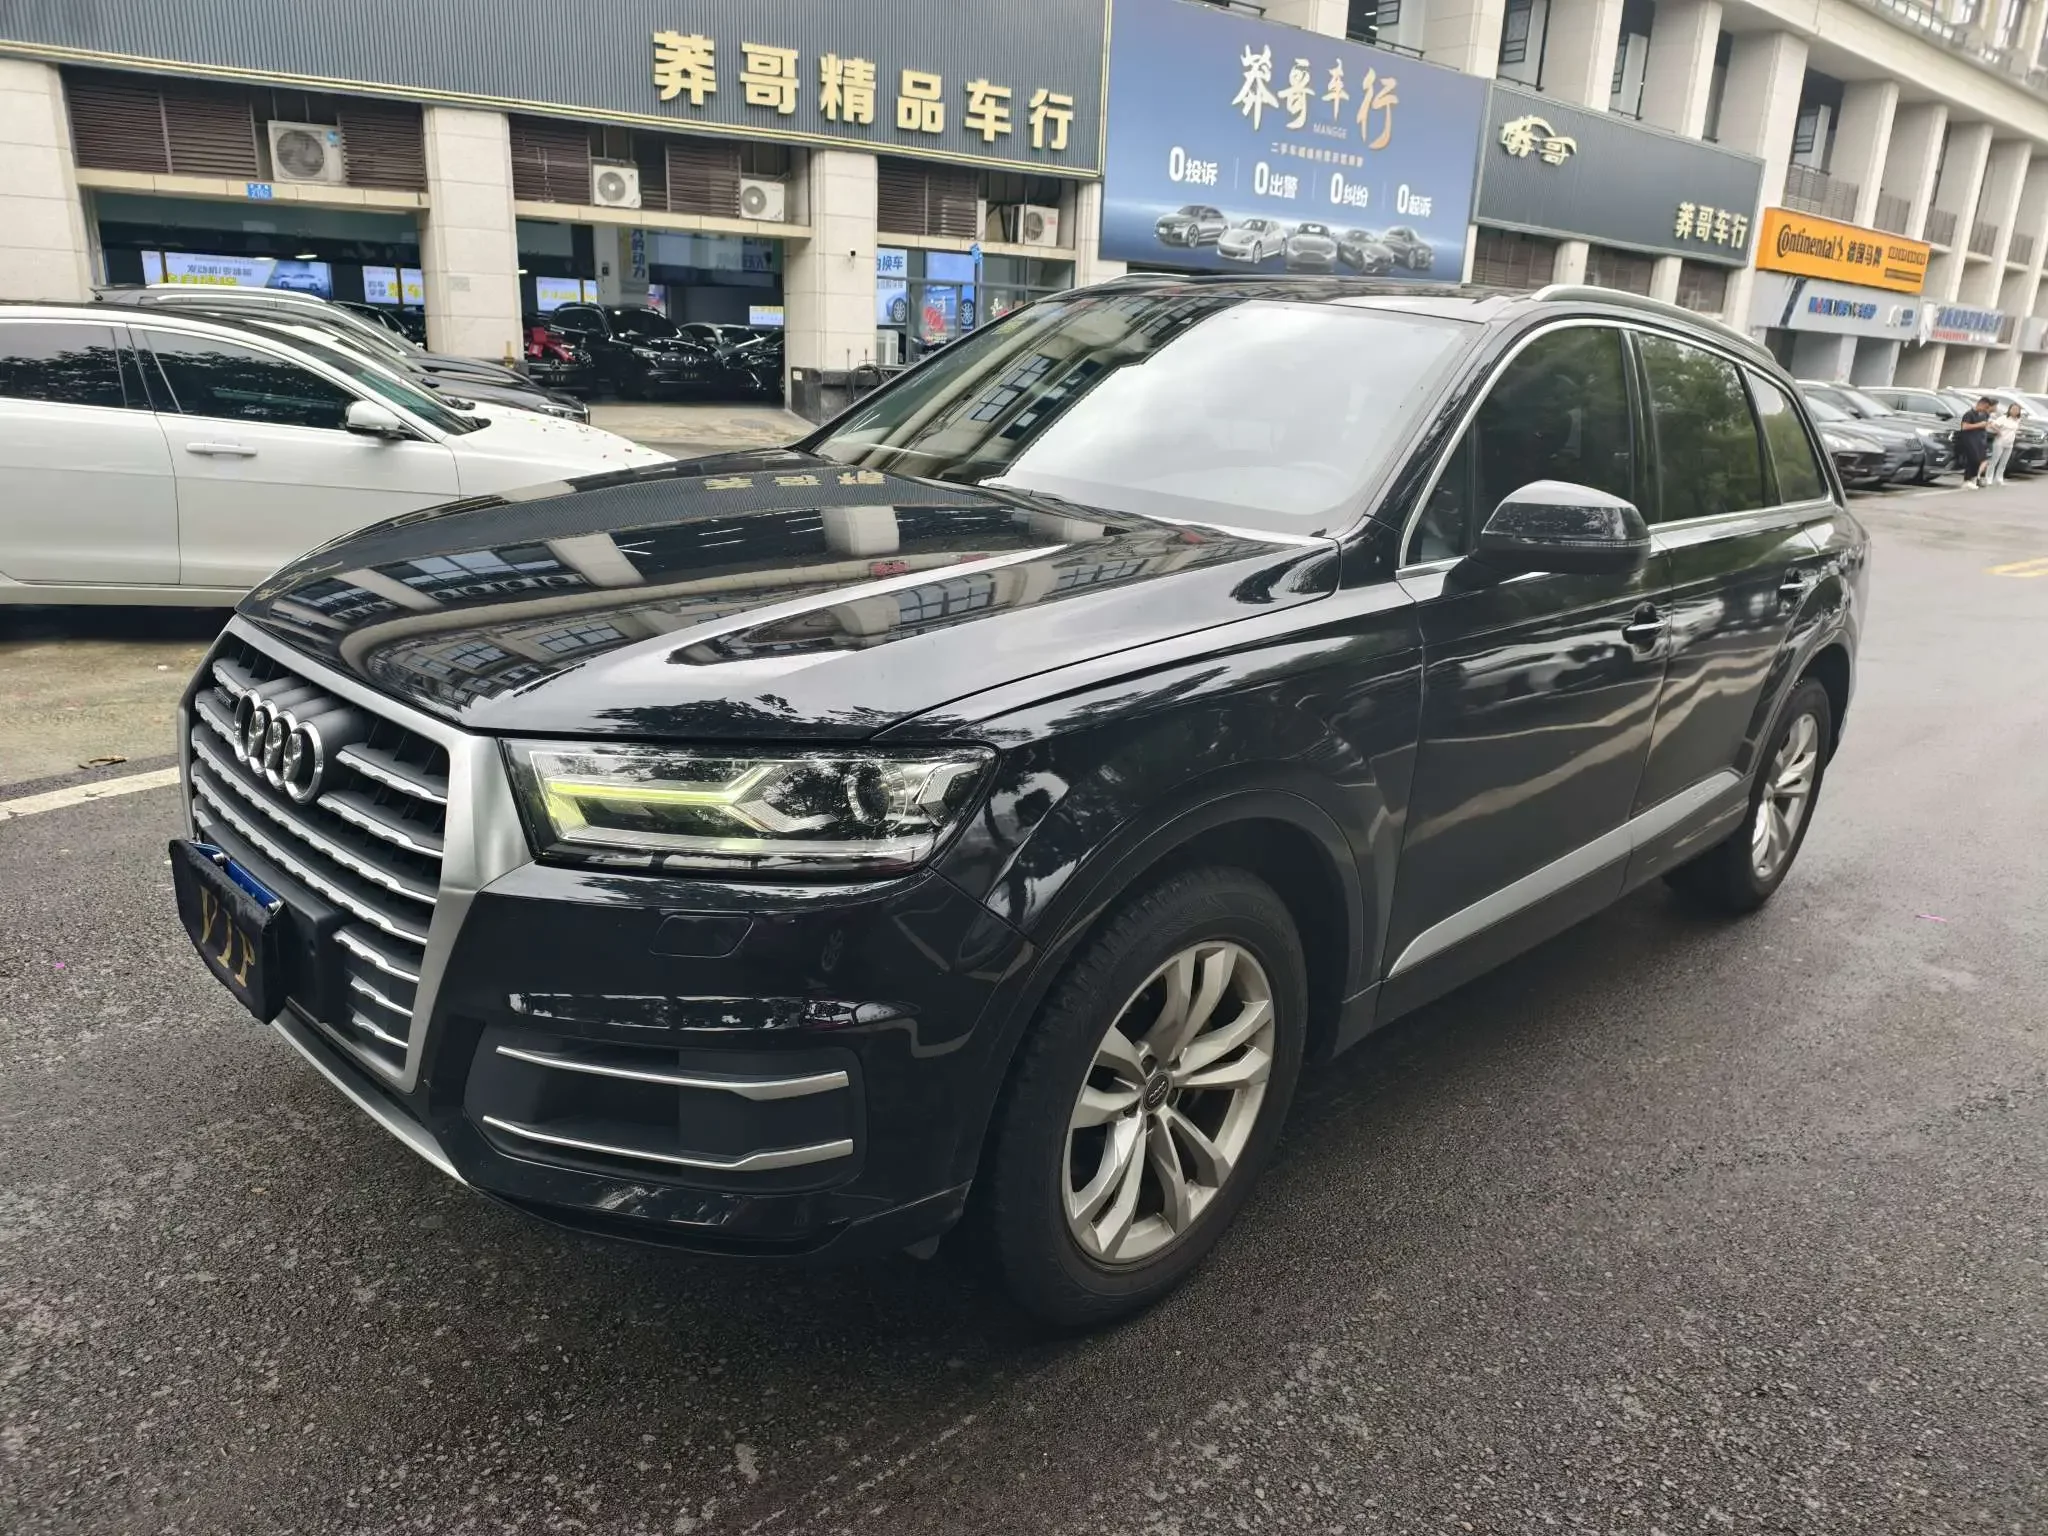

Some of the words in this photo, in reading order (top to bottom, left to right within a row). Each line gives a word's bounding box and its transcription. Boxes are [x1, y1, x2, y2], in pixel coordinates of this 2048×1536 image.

[653, 30, 1074, 150] 莽哥精品车行
[1676, 202, 1748, 249] 莽哥车行
[1777, 223, 1836, 260] Continental
